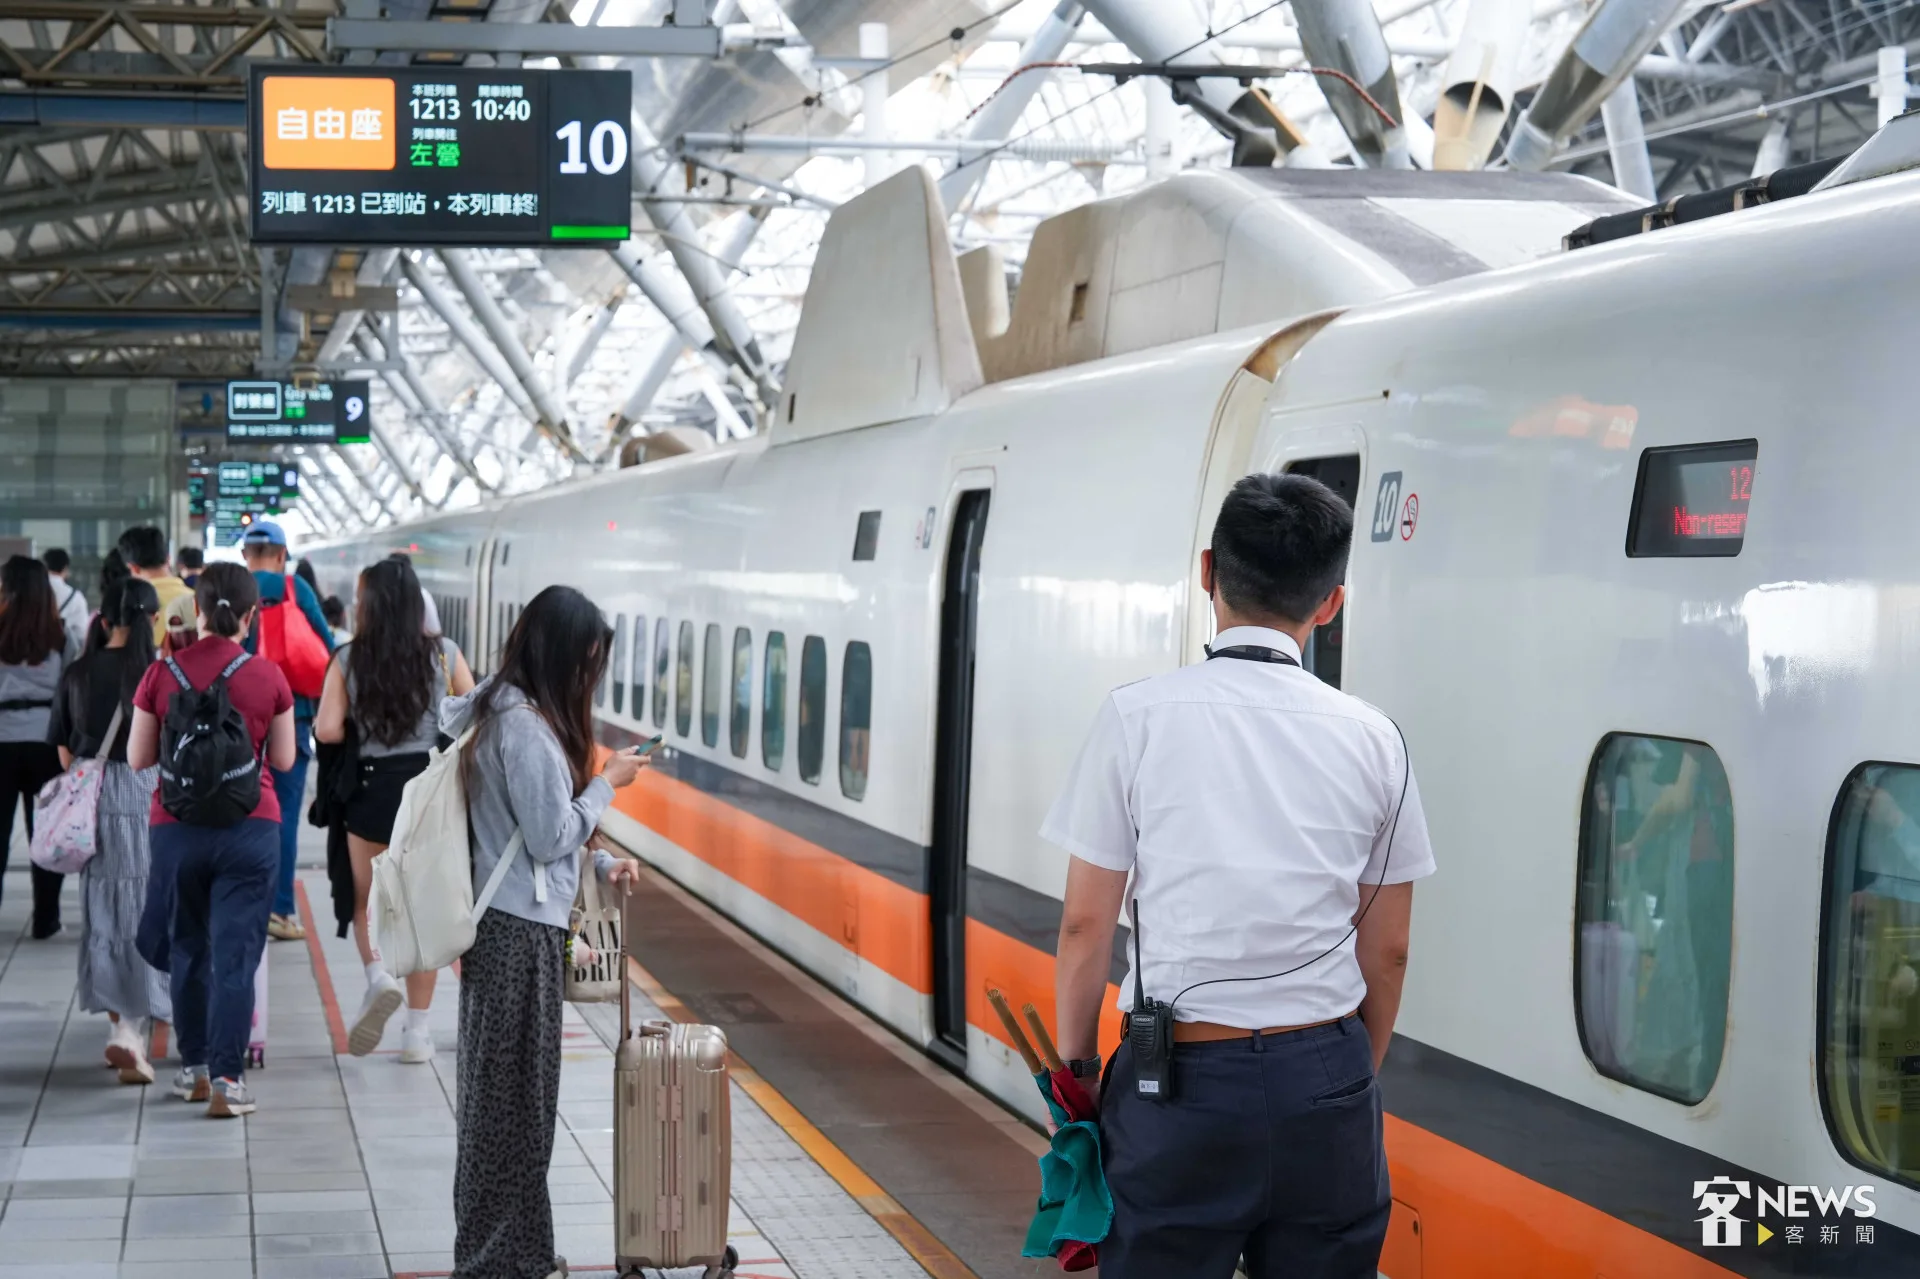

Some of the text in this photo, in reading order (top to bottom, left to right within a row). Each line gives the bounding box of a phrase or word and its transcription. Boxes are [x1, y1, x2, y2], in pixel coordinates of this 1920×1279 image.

[409, 98, 461, 121] 1213
[471, 99, 531, 121] 10:40
[277, 107, 383, 141] 自由座
[409, 142, 460, 167] 左營
[555, 120, 628, 175] 10
[262, 191, 539, 216] 列車 1213 已到站,本列車終
[345, 396, 364, 422] 9
[1730, 466, 1752, 499] 12
[1374, 480, 1398, 534] 10
[1673, 506, 1747, 535] Non-reser
